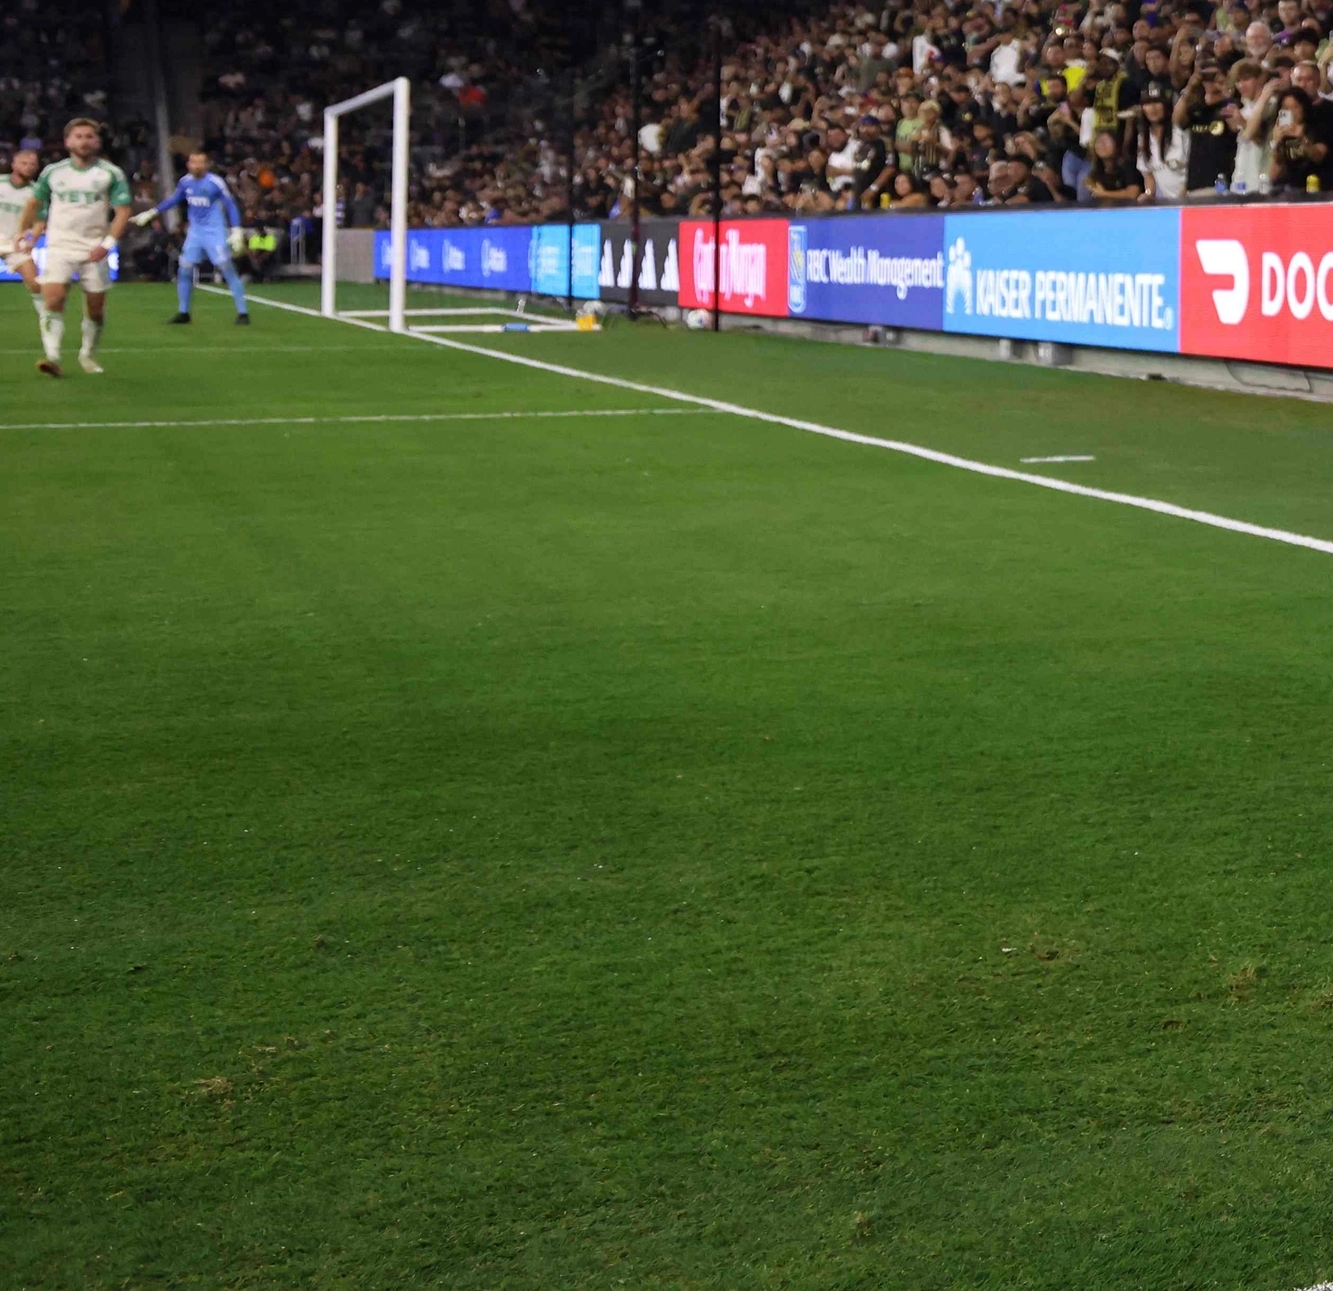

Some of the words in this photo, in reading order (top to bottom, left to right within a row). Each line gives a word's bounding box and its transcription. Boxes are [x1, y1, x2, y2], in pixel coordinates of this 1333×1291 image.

[806, 248, 828, 284] RBC
[828, 245, 866, 284] Wealth
[866, 248, 945, 300] Management
[976, 269, 1032, 320] KAISER
